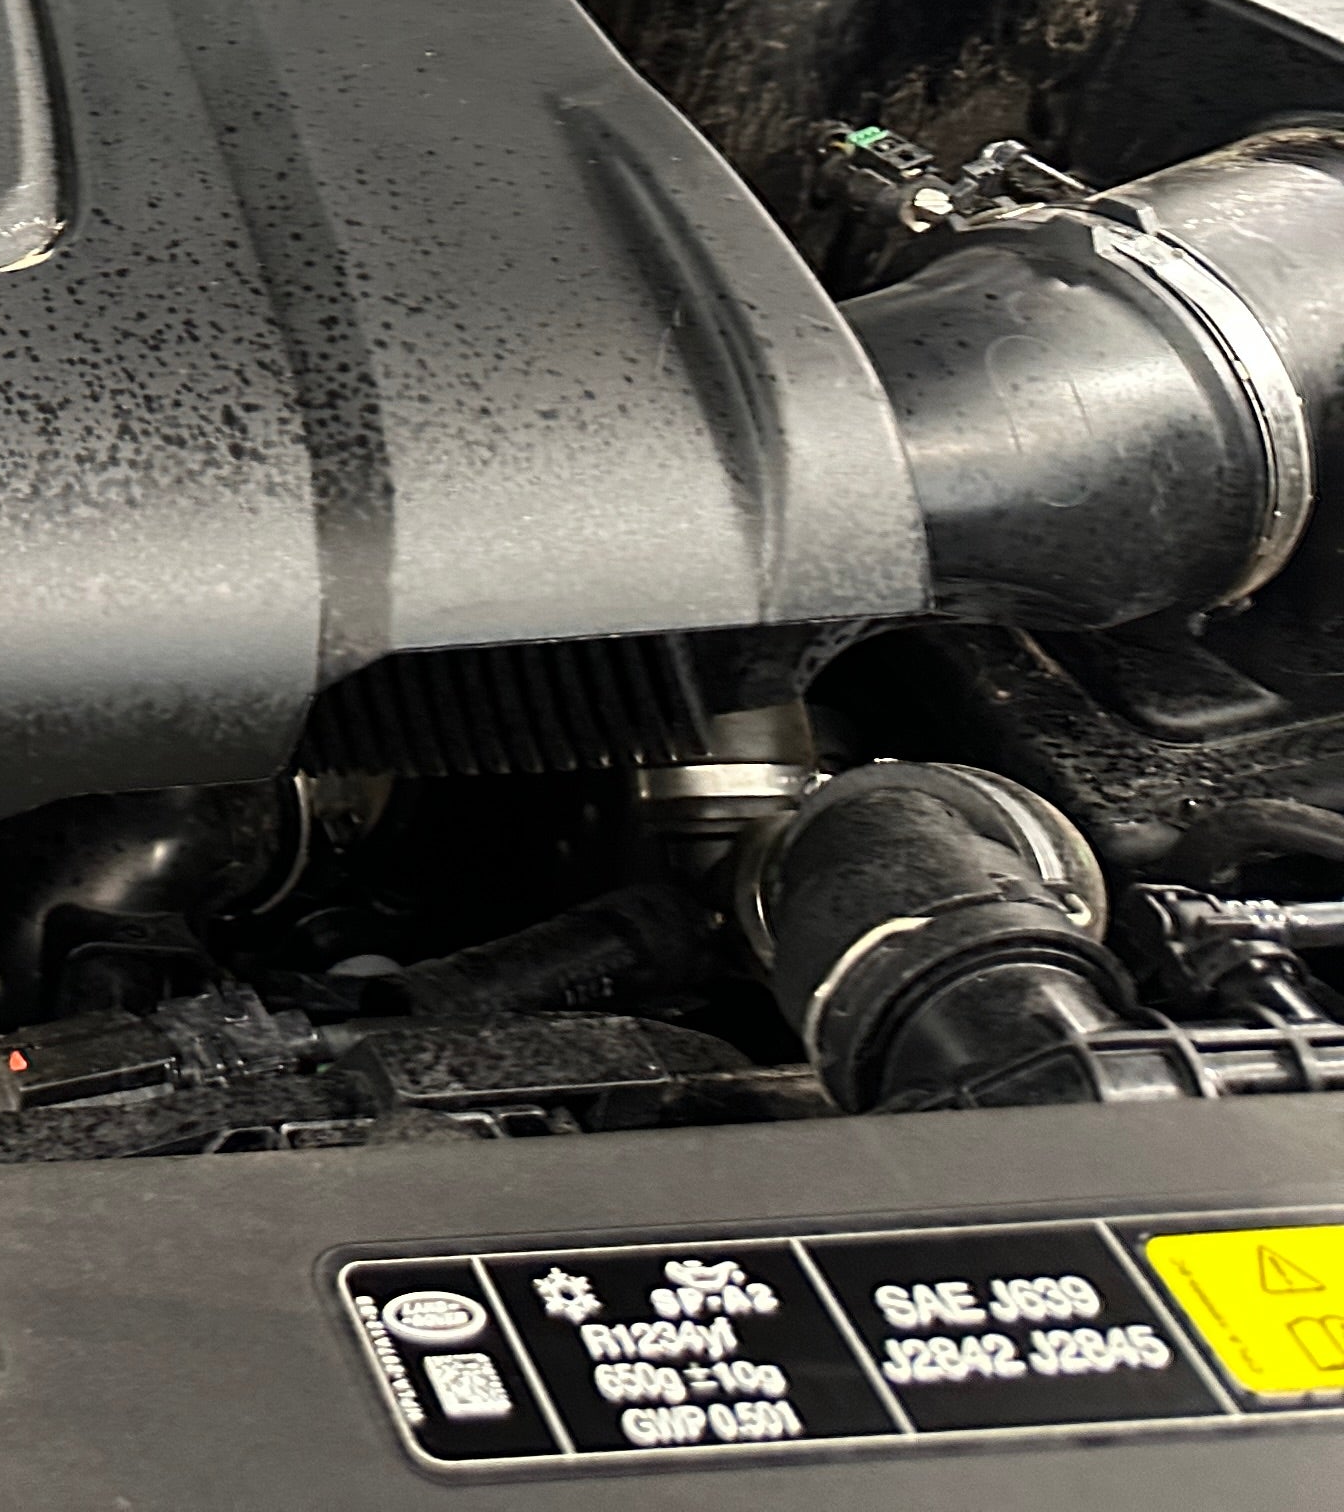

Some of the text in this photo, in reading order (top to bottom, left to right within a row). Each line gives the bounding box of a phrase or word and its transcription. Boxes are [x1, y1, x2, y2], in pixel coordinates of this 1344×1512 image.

[874, 1275, 1101, 1329] SAE J639
[882, 1324, 1171, 1384] J2842 J2845
[594, 1361, 687, 1405] 650g
[621, 1404, 707, 1447] GWP
